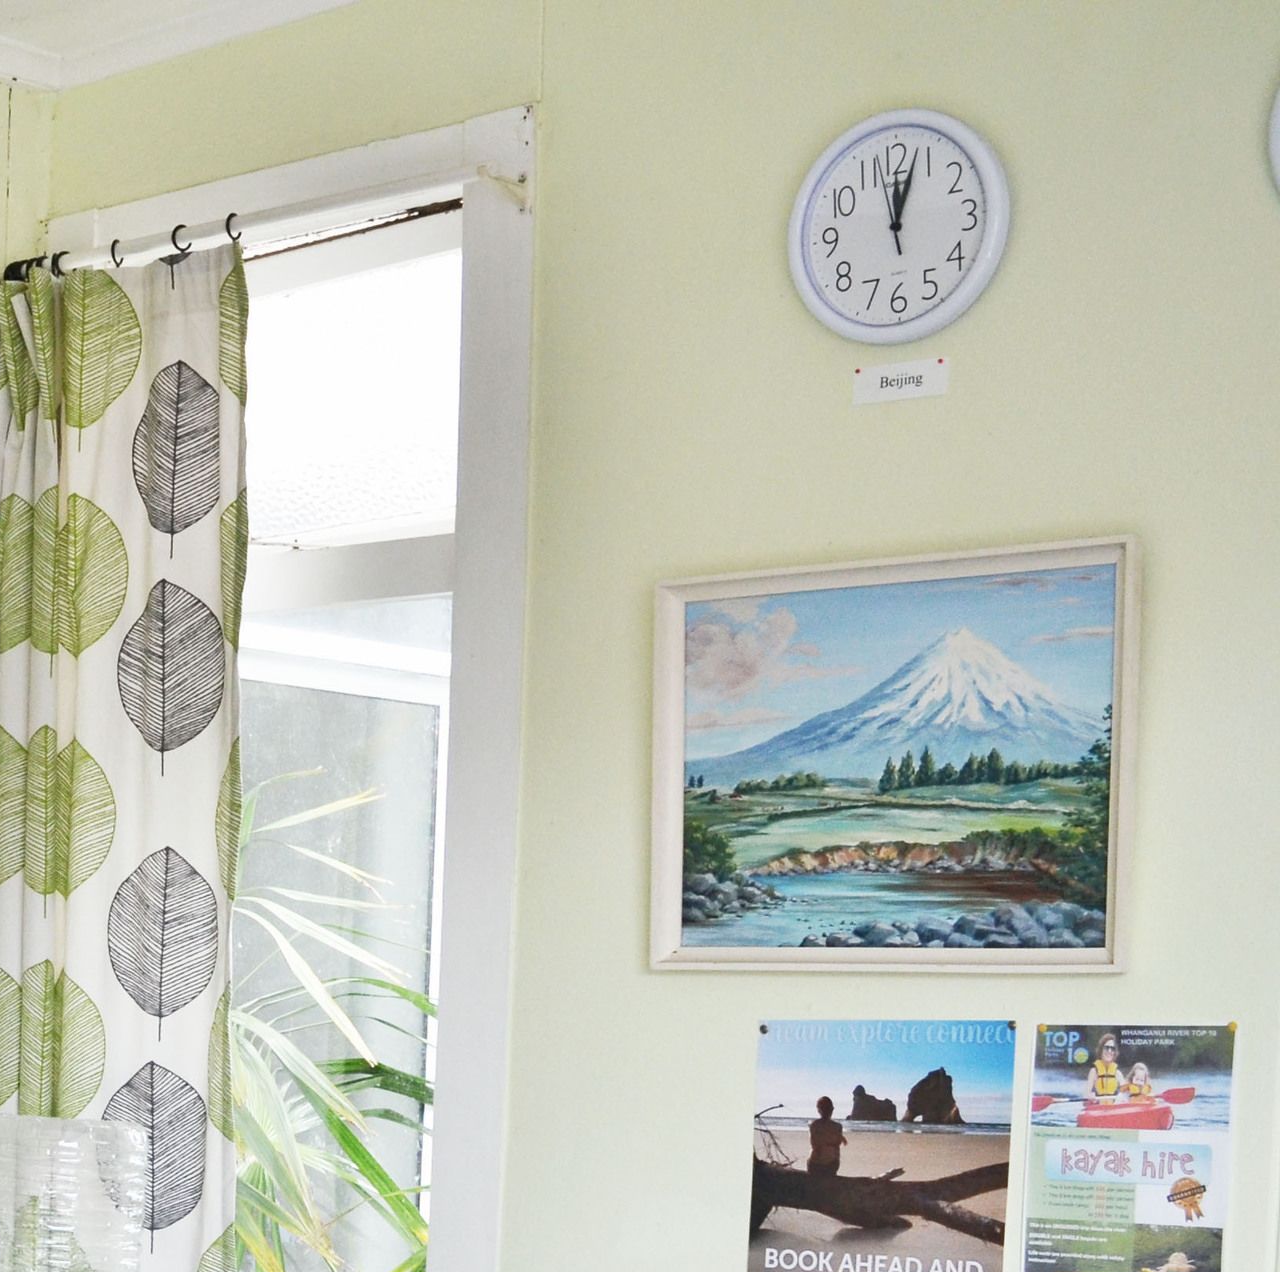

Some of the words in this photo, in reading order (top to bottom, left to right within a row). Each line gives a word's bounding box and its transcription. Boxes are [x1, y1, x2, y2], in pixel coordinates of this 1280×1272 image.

[861, 157, 877, 190] 11
[886, 143, 908, 177] 12
[927, 146, 931, 177] 1
[946, 161, 964, 195] 2
[833, 185, 856, 219] 10
[961, 198, 978, 231] 3
[822, 227, 839, 259] 9
[946, 240, 965, 272] 4
[835, 260, 852, 292] 8
[921, 268, 938, 300] 5
[861, 278, 880, 311] 7
[890, 281, 908, 313] 6
[880, 373, 923, 389] Beijing
[767, 1023, 828, 1042] ream
[838, 1020, 919, 1047] explore
[1043, 1031, 1080, 1047] TOP
[1121, 1029, 1166, 1037] WHANGANUI
[1061, 1148, 1132, 1177] kayak
[1141, 1151, 1195, 1179] hire
[765, 1248, 833, 1272] BOOK
